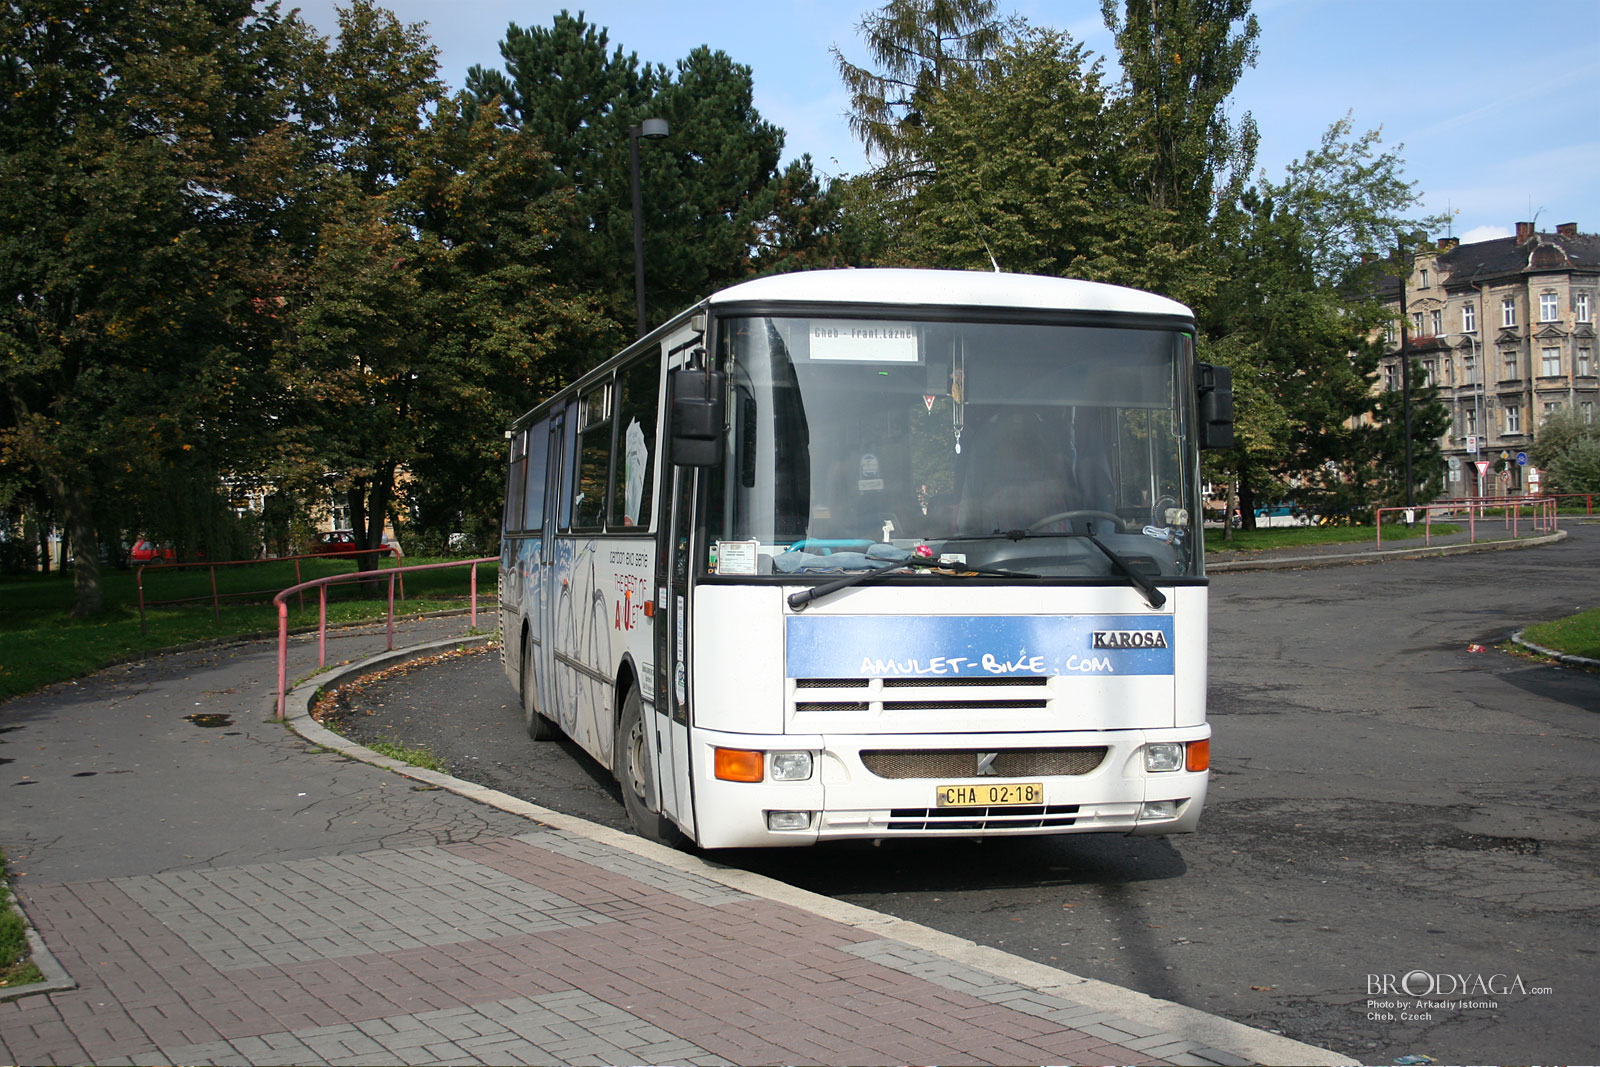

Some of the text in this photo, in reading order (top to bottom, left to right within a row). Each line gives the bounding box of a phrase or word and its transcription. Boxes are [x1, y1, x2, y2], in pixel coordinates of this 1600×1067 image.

[814, 327, 839, 338] Cheb
[1093, 630, 1167, 649] KAROSA
[946, 785, 1034, 804] CHA 02-18
